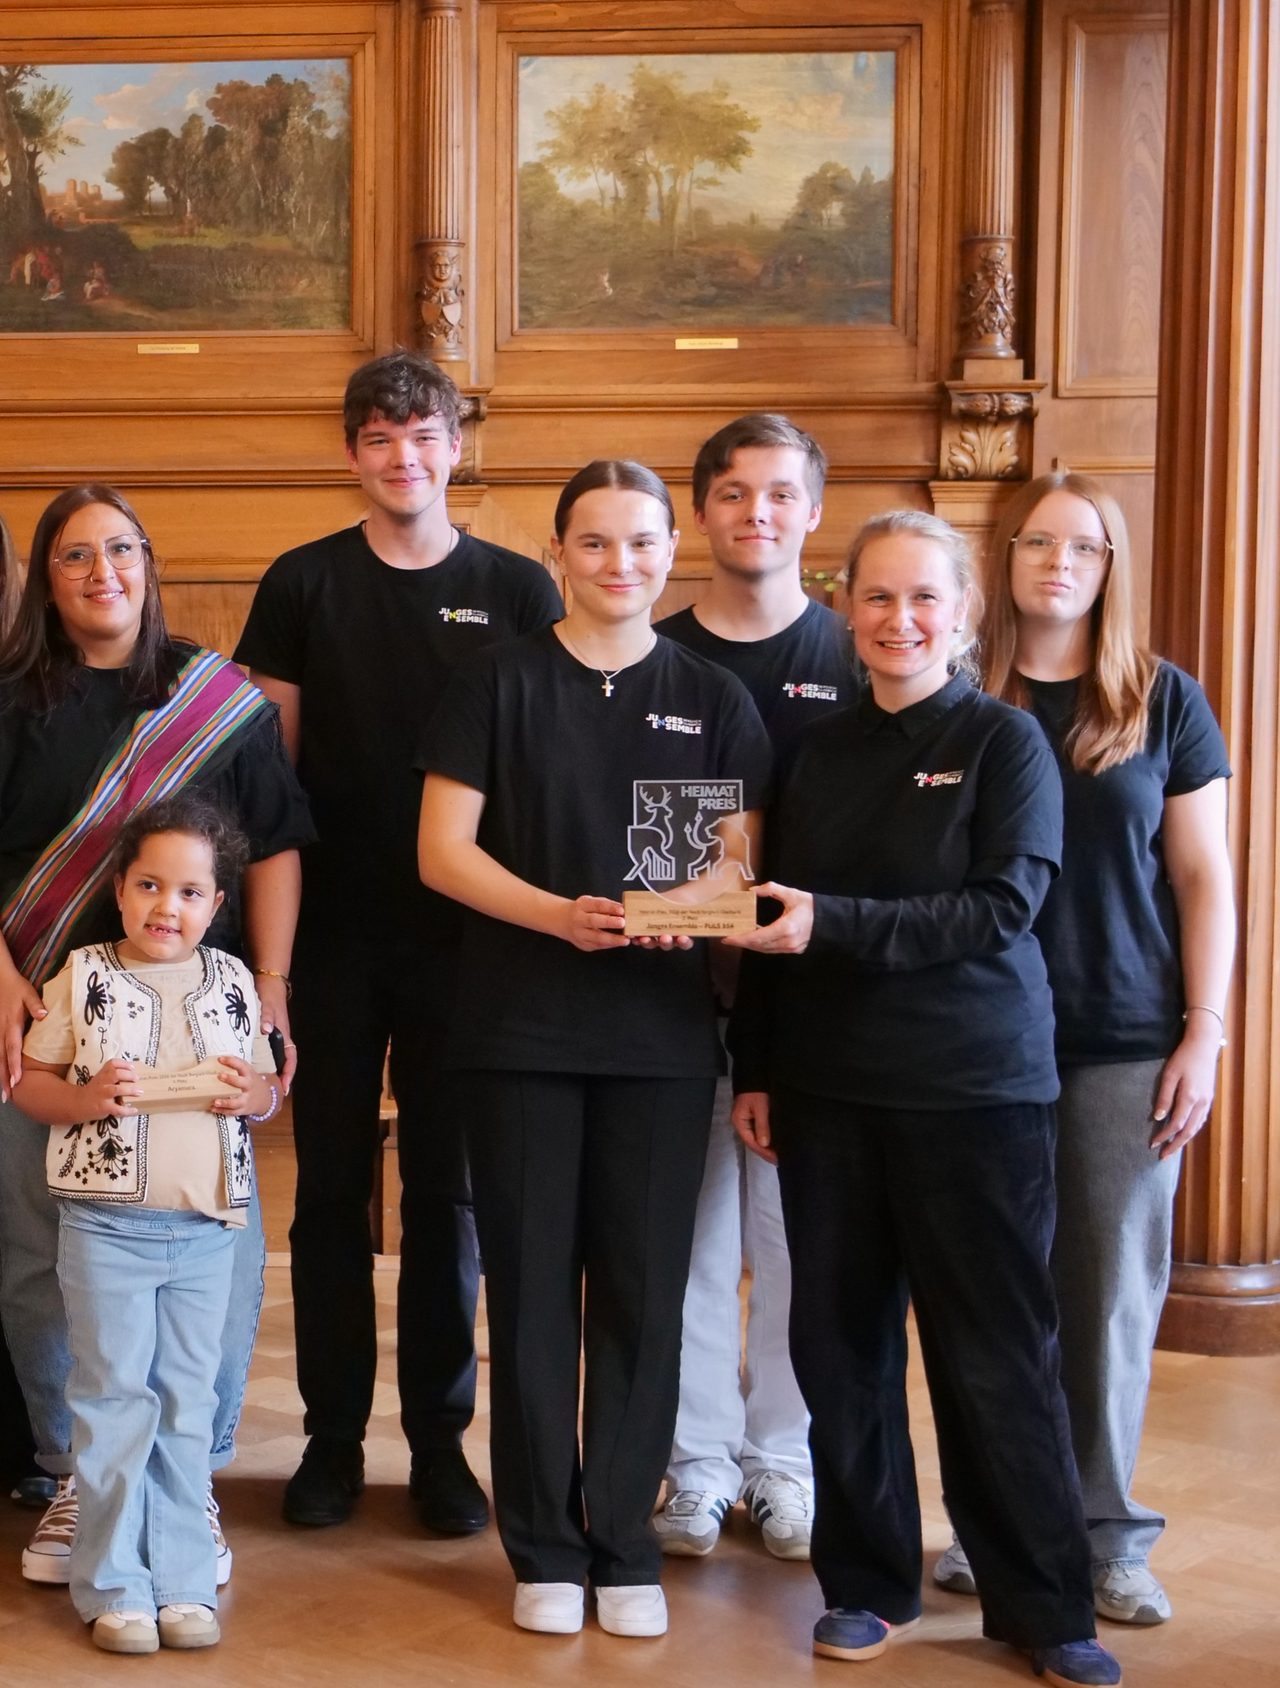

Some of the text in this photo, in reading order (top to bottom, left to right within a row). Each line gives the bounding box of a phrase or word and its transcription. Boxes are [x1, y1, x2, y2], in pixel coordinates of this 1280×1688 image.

[439, 608, 473, 619] JUNGES
[782, 683, 819, 694] JUNGES
[645, 713, 684, 726] JUNGES
[681, 785, 737, 798] HEIMAT
[698, 798, 737, 810] PREIS
